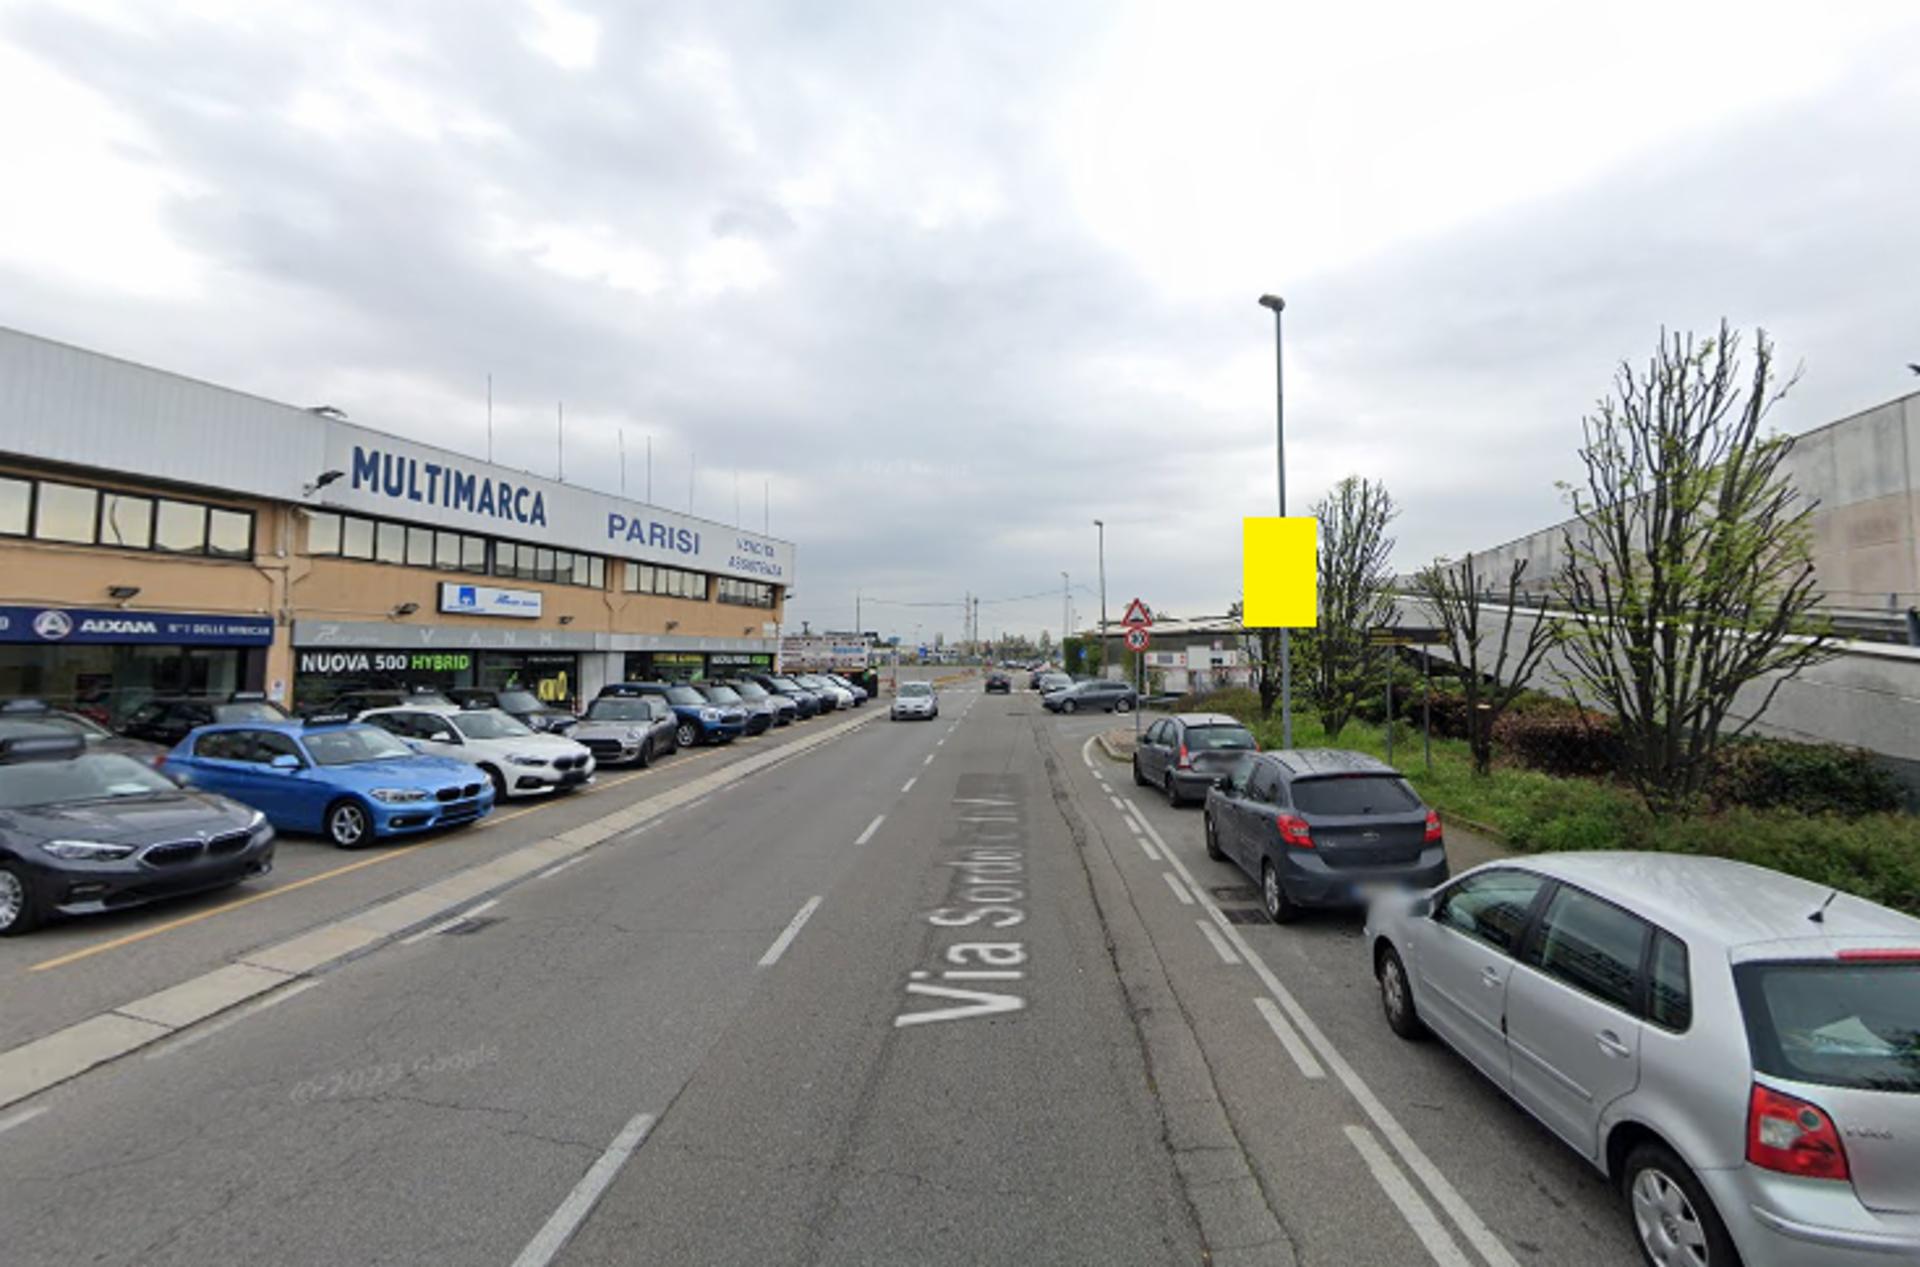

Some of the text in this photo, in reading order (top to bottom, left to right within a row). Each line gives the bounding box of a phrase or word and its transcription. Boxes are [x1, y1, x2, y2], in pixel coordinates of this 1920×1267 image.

[351, 446, 546, 528] MULTIMARCA
[607, 511, 700, 555] PARISI
[80, 618, 157, 635] AIXAM
[193, 624, 225, 635] DELLE
[301, 654, 470, 673] NUOVA 500 HYBRID
